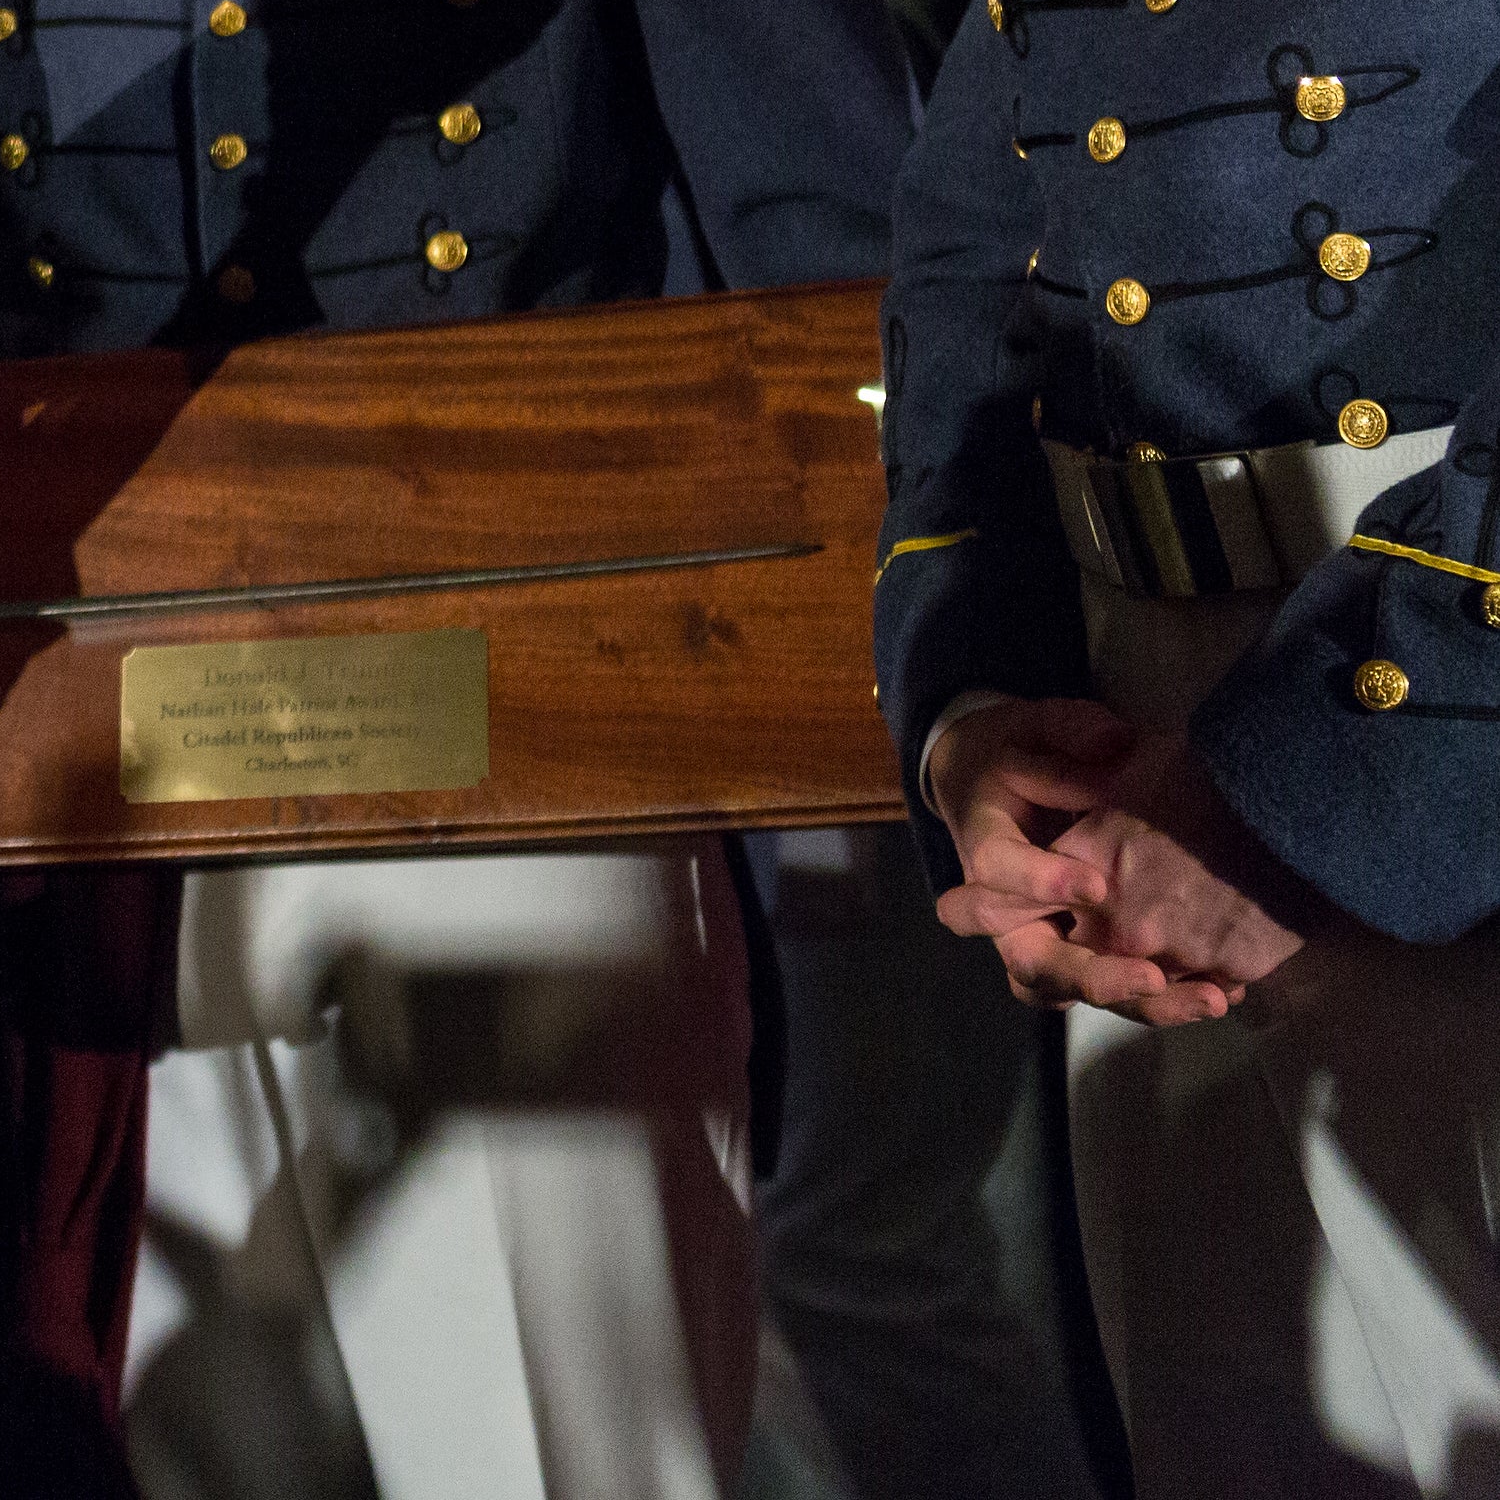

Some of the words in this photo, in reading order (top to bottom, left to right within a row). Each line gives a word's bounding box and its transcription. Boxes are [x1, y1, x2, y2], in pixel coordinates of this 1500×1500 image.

[159, 700, 226, 721] Nathan
[231, 697, 272, 717] Hale
[181, 728, 248, 749] Citadel
[252, 723, 354, 750] Republican
[358, 719, 422, 744] Society
